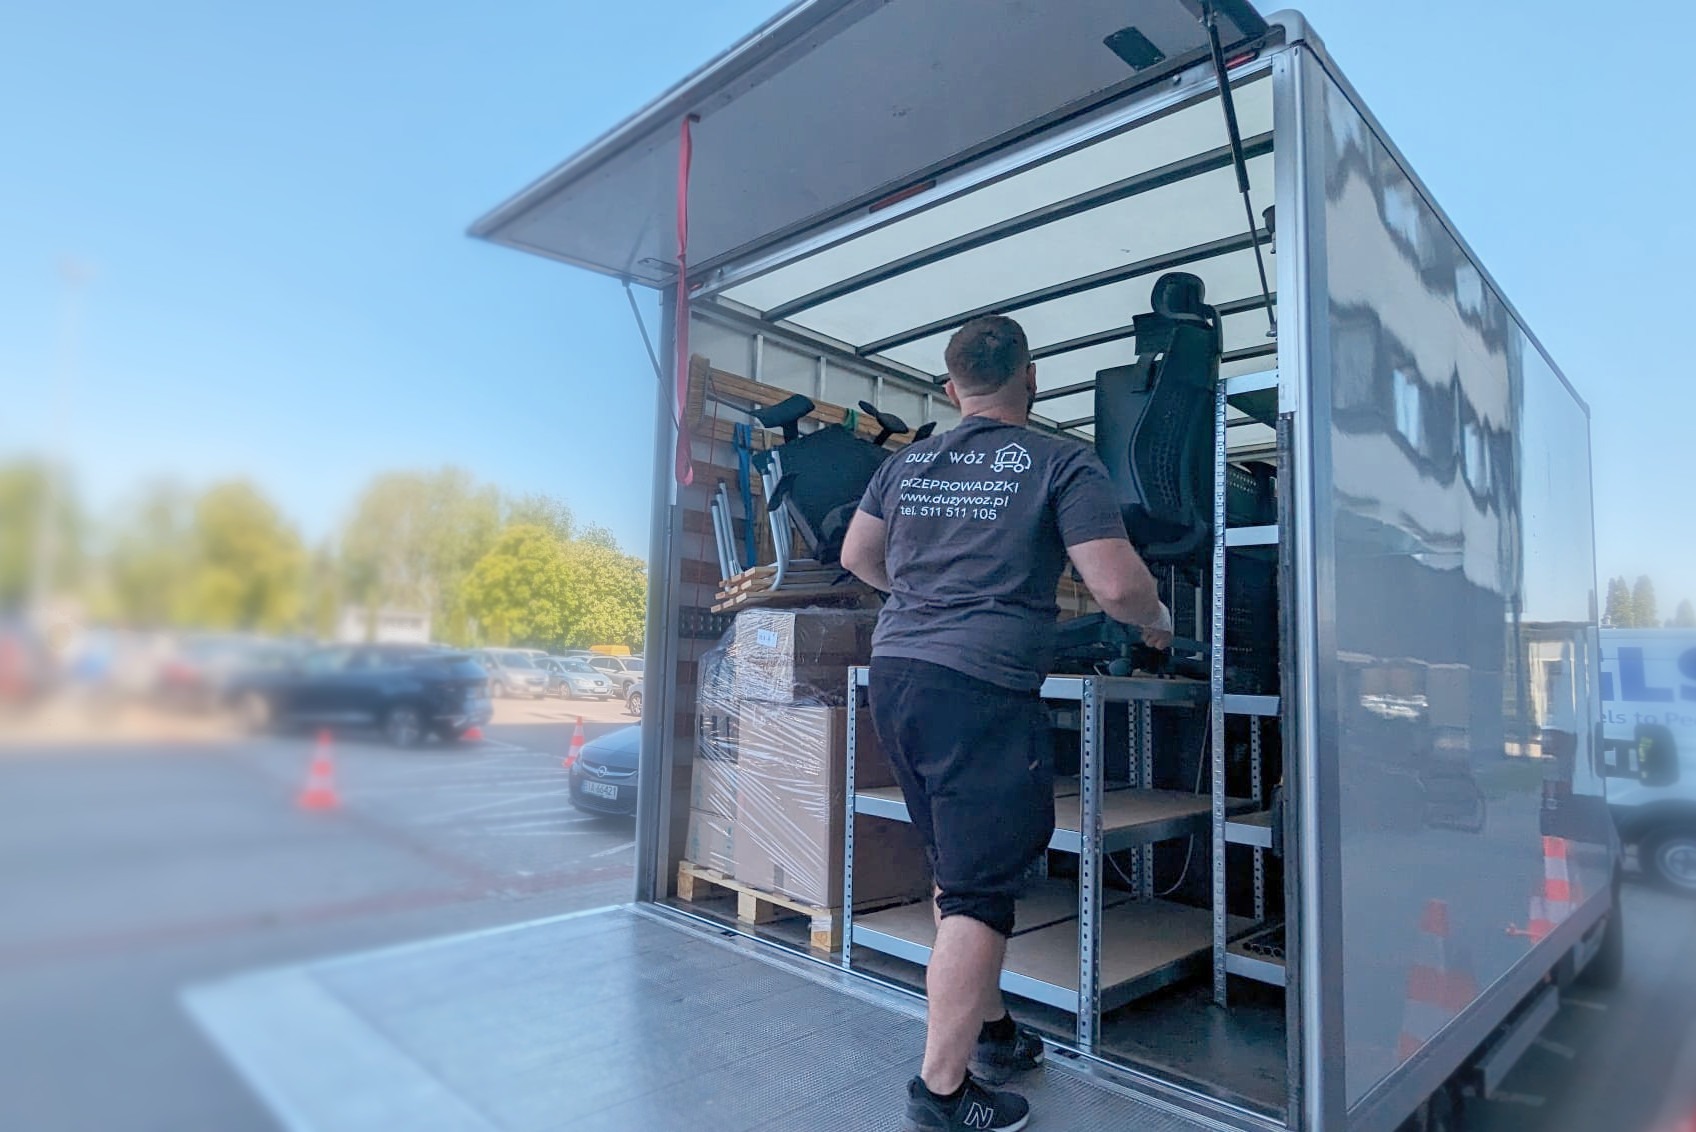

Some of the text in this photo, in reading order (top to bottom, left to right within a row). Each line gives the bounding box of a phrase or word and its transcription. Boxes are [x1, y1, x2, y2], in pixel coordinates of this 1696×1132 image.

[949, 450, 986, 464] WÓZ
[900, 506, 997, 520] tel. 511 511 105
[1633, 711, 1657, 724] to
[1665, 712, 1696, 727] Pe
[963, 1102, 994, 1129] N
